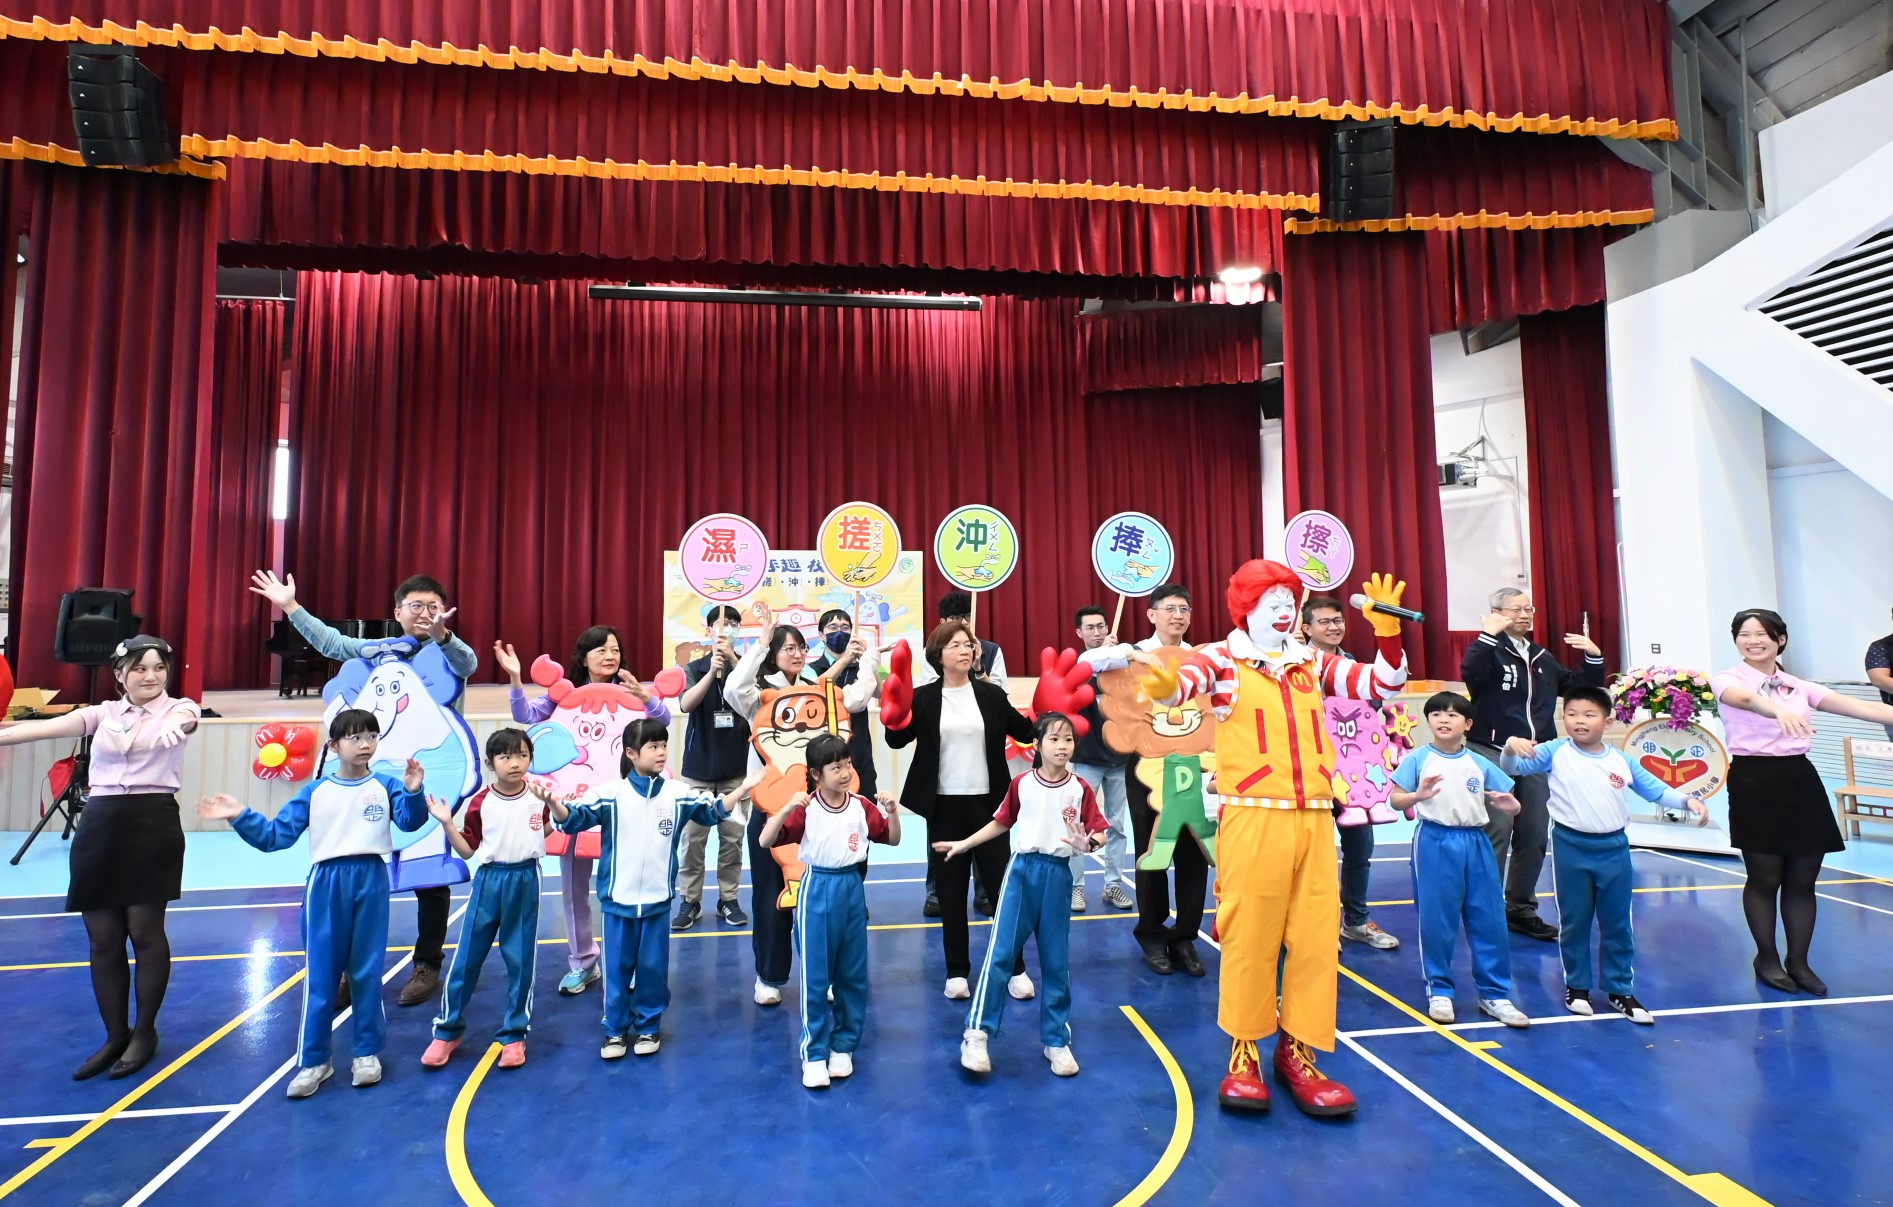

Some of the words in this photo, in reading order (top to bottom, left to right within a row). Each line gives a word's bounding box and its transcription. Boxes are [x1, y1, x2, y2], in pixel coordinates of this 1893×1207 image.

[702, 527, 736, 563] 濕
[838, 515, 871, 551] 搓
[956, 519, 988, 553] 沖
[1110, 522, 1145, 557] 捧
[1301, 520, 1332, 556] 擦
[1698, 733, 1716, 753] School
[1175, 766, 1194, 792] D
[1686, 776, 1720, 797] 國民小學
